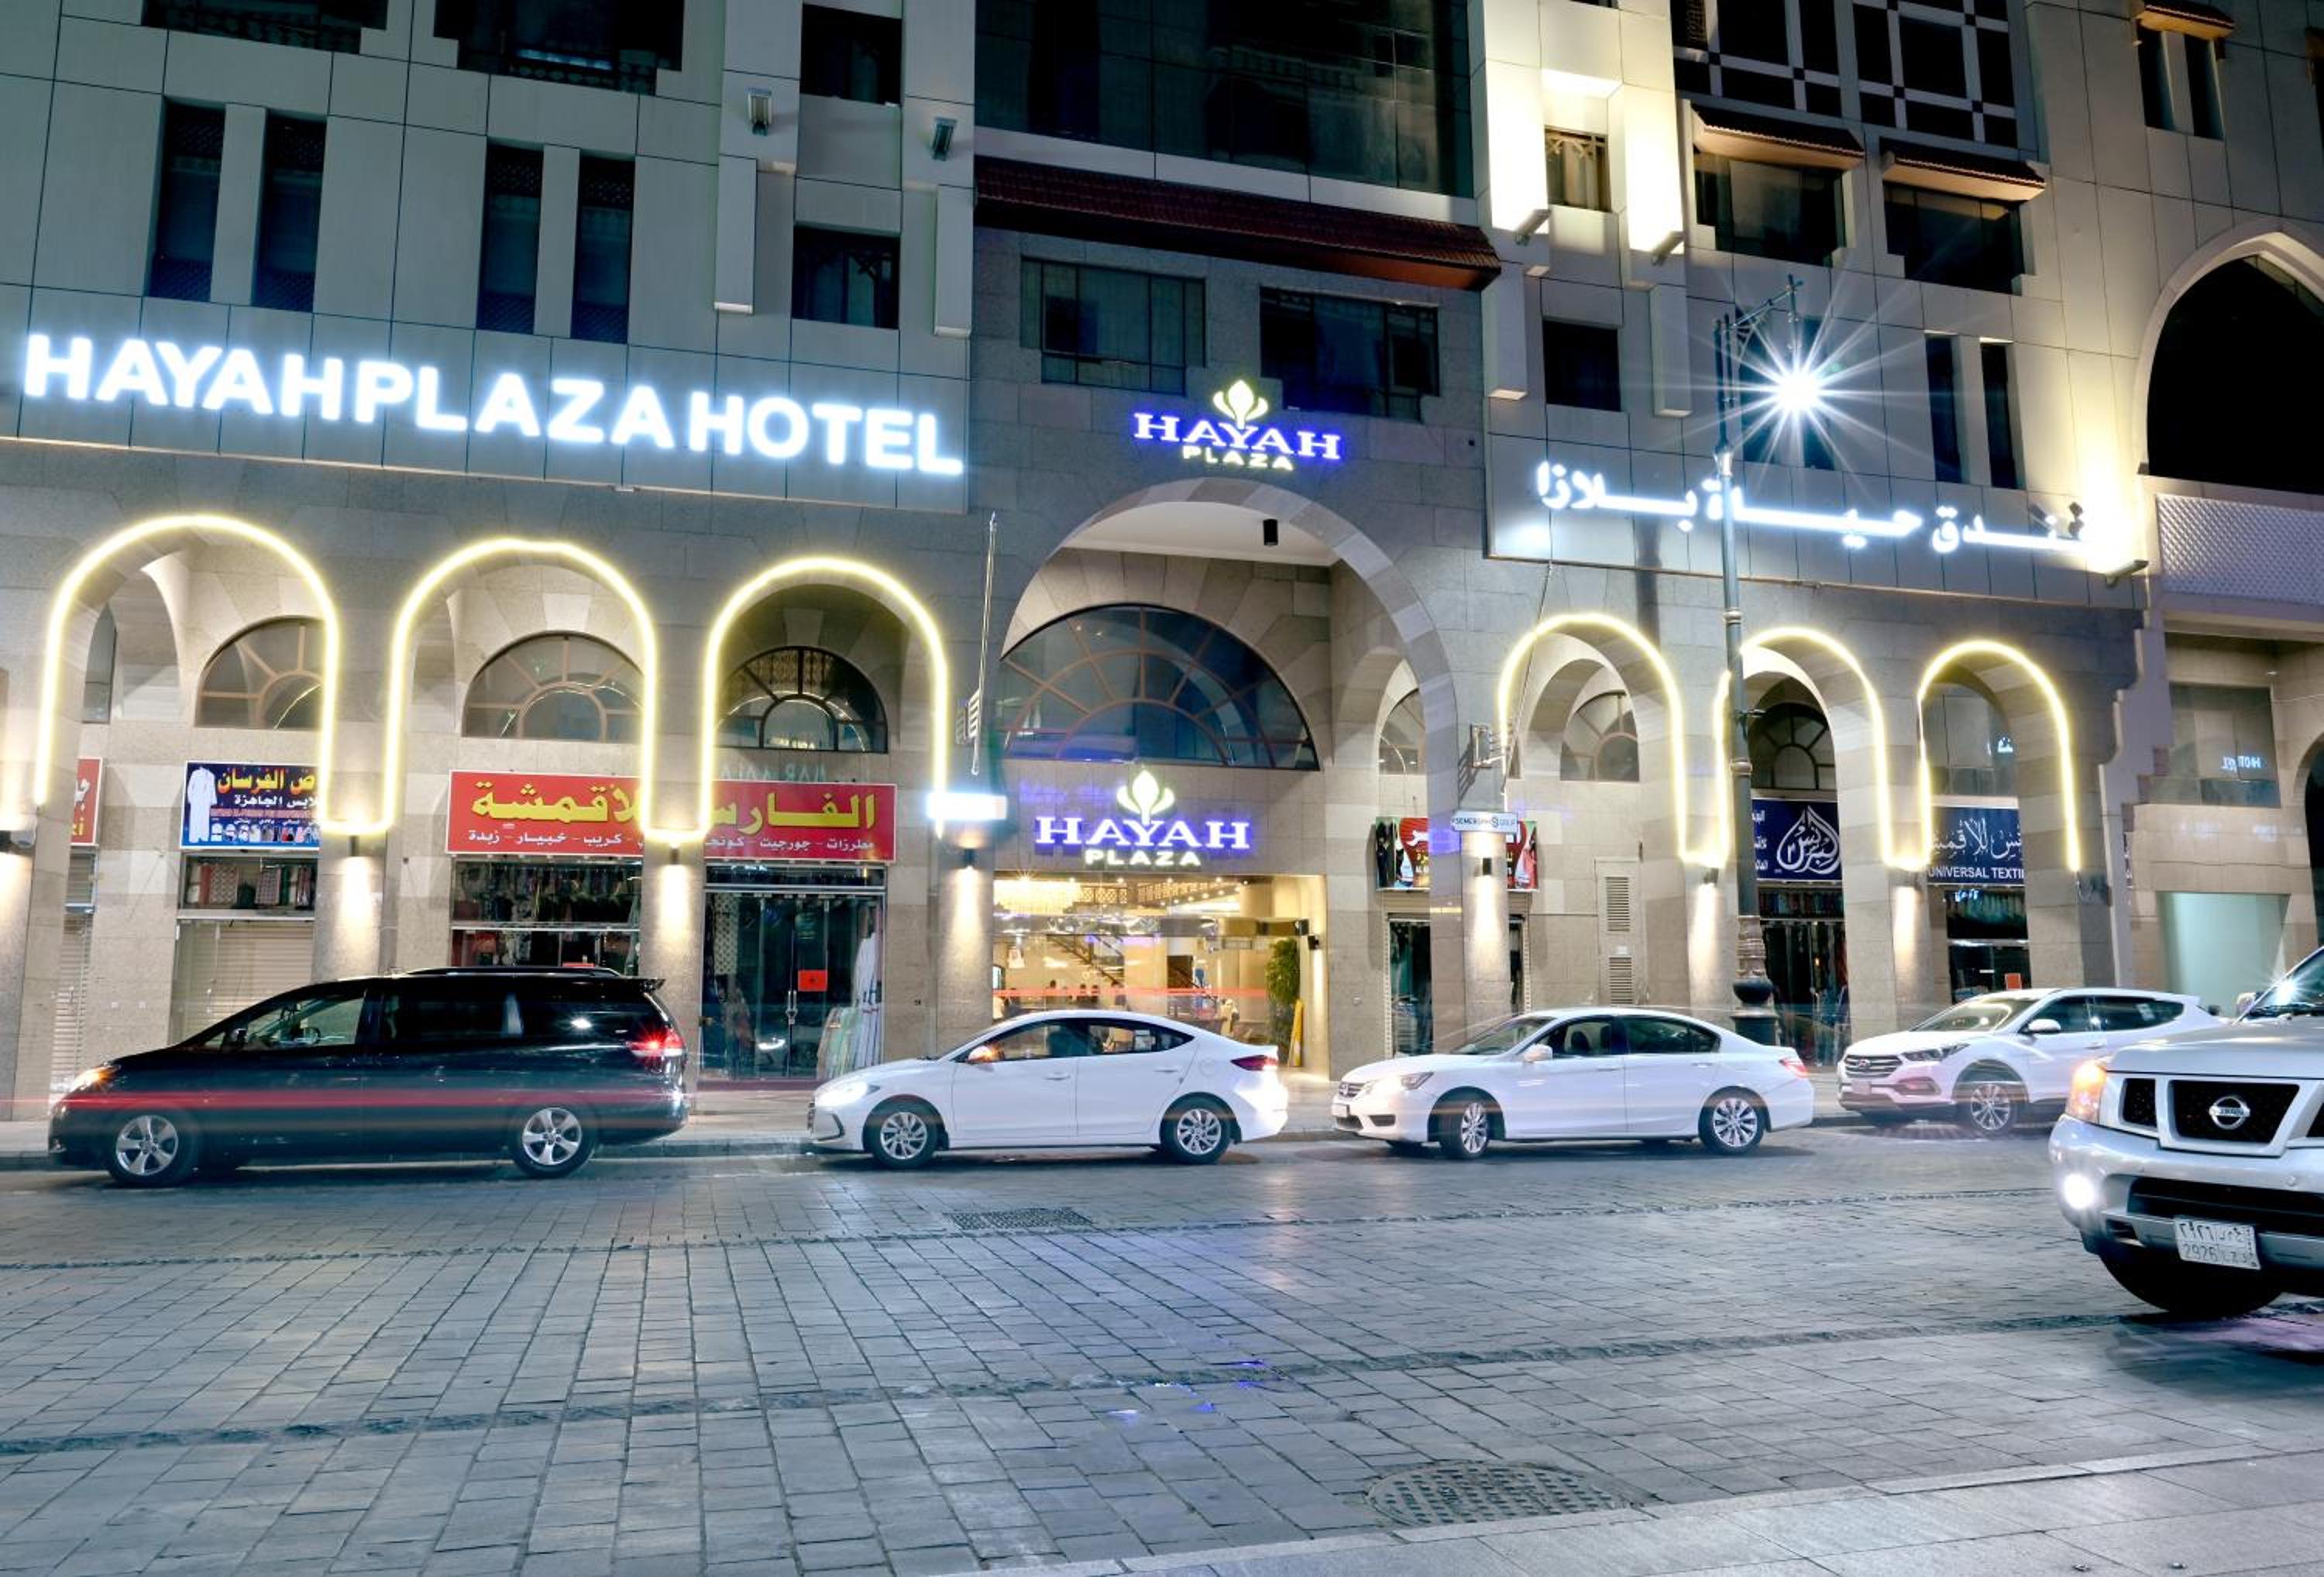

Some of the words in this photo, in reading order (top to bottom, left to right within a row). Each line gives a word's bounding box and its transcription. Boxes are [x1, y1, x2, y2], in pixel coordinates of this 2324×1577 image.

[23, 333, 343, 421] HAYAH
[354, 359, 676, 451] PLAZA
[688, 390, 964, 476] HOTEL
[1133, 411, 1341, 460] HAYAH
[1181, 445, 1294, 471] PLAZA
[1536, 460, 1698, 532] بلازا
[1701, 477, 1923, 550] حياة
[1932, 501, 2085, 554] فندق
[217, 768, 285, 794] الفرسان
[234, 794, 283, 807] الجاهزة
[1034, 815, 1250, 850] HAYAH
[1085, 850, 1202, 867] PLAZA
[1927, 866, 1990, 879] UNIVERSAL
